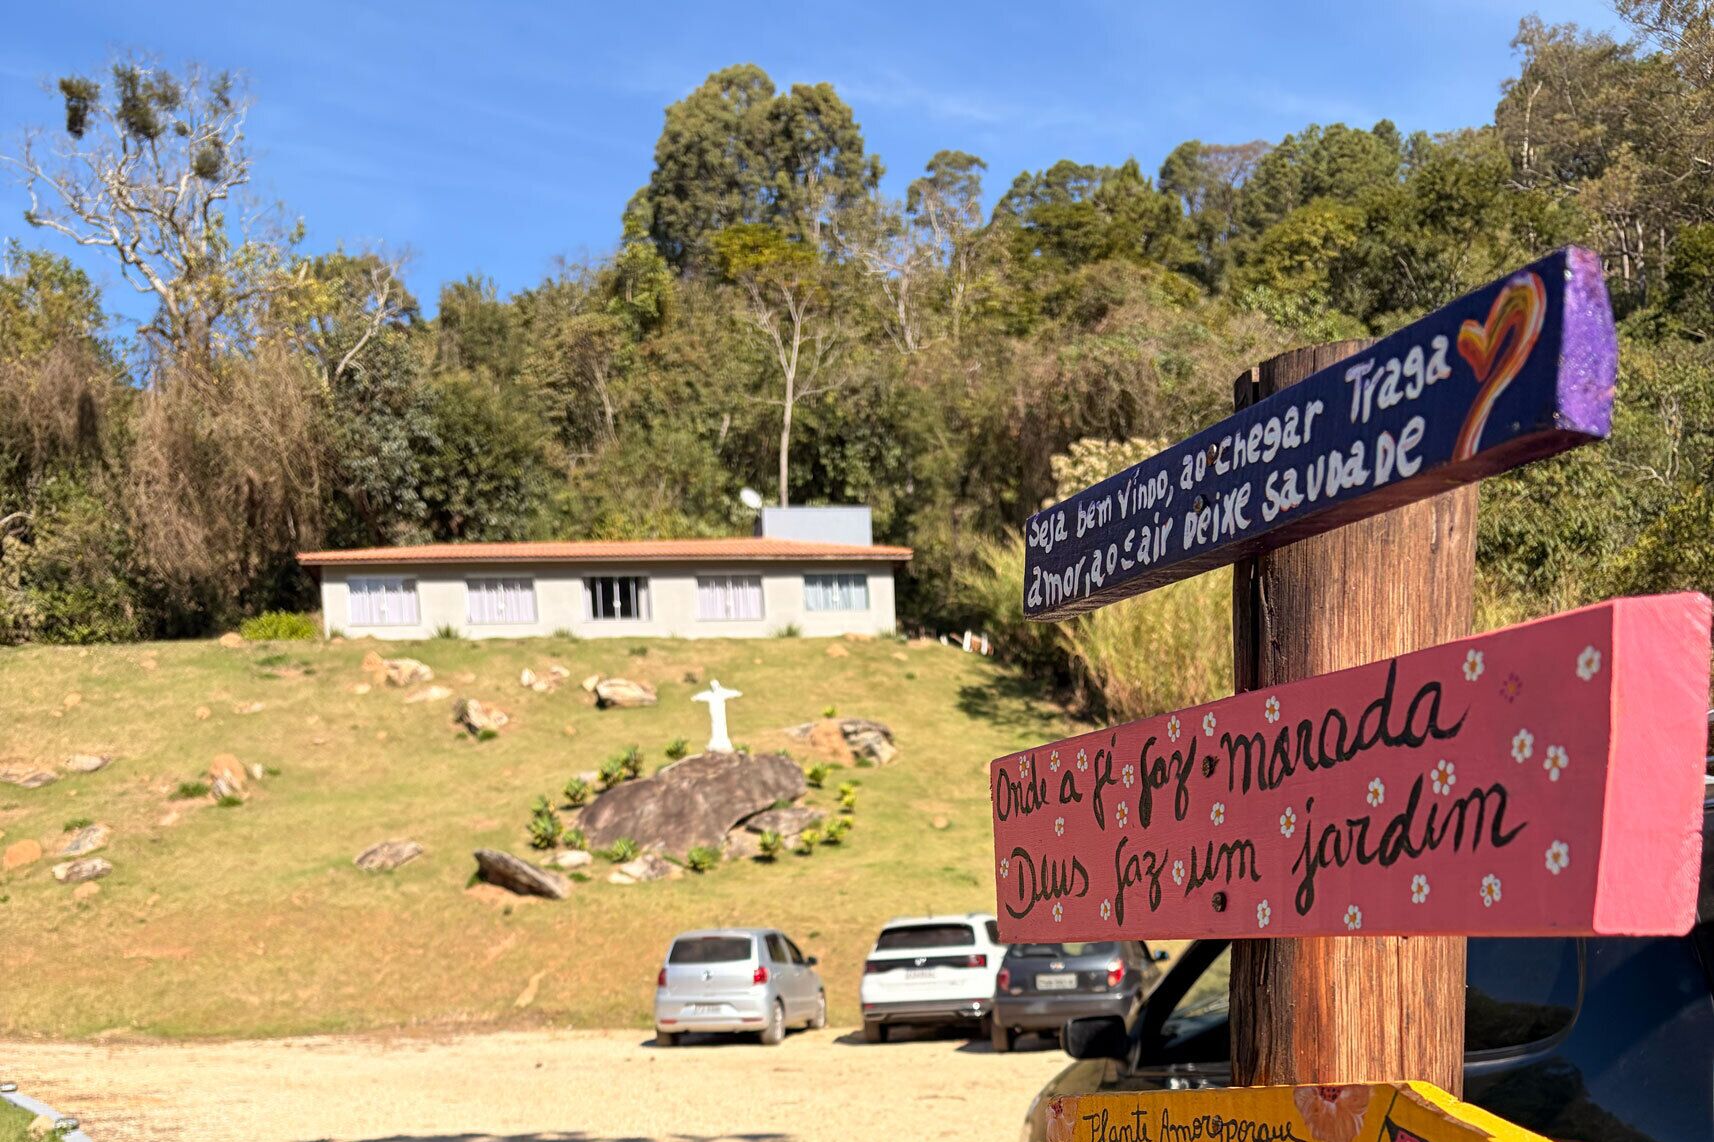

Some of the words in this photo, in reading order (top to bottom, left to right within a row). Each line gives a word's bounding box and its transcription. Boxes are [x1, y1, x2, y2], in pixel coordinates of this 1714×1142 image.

[1180, 450, 1206, 490] ao
[1345, 334, 1452, 424] Traga
[997, 753, 1050, 822] Onde
[1059, 770, 1083, 804] a
[1139, 736, 1196, 829] faz
[1220, 658, 1471, 795] morada
[1005, 847, 1089, 919] Deus
[1115, 836, 1168, 927] faz
[1185, 838, 1261, 897] um
[1292, 775, 1529, 917] jardim
